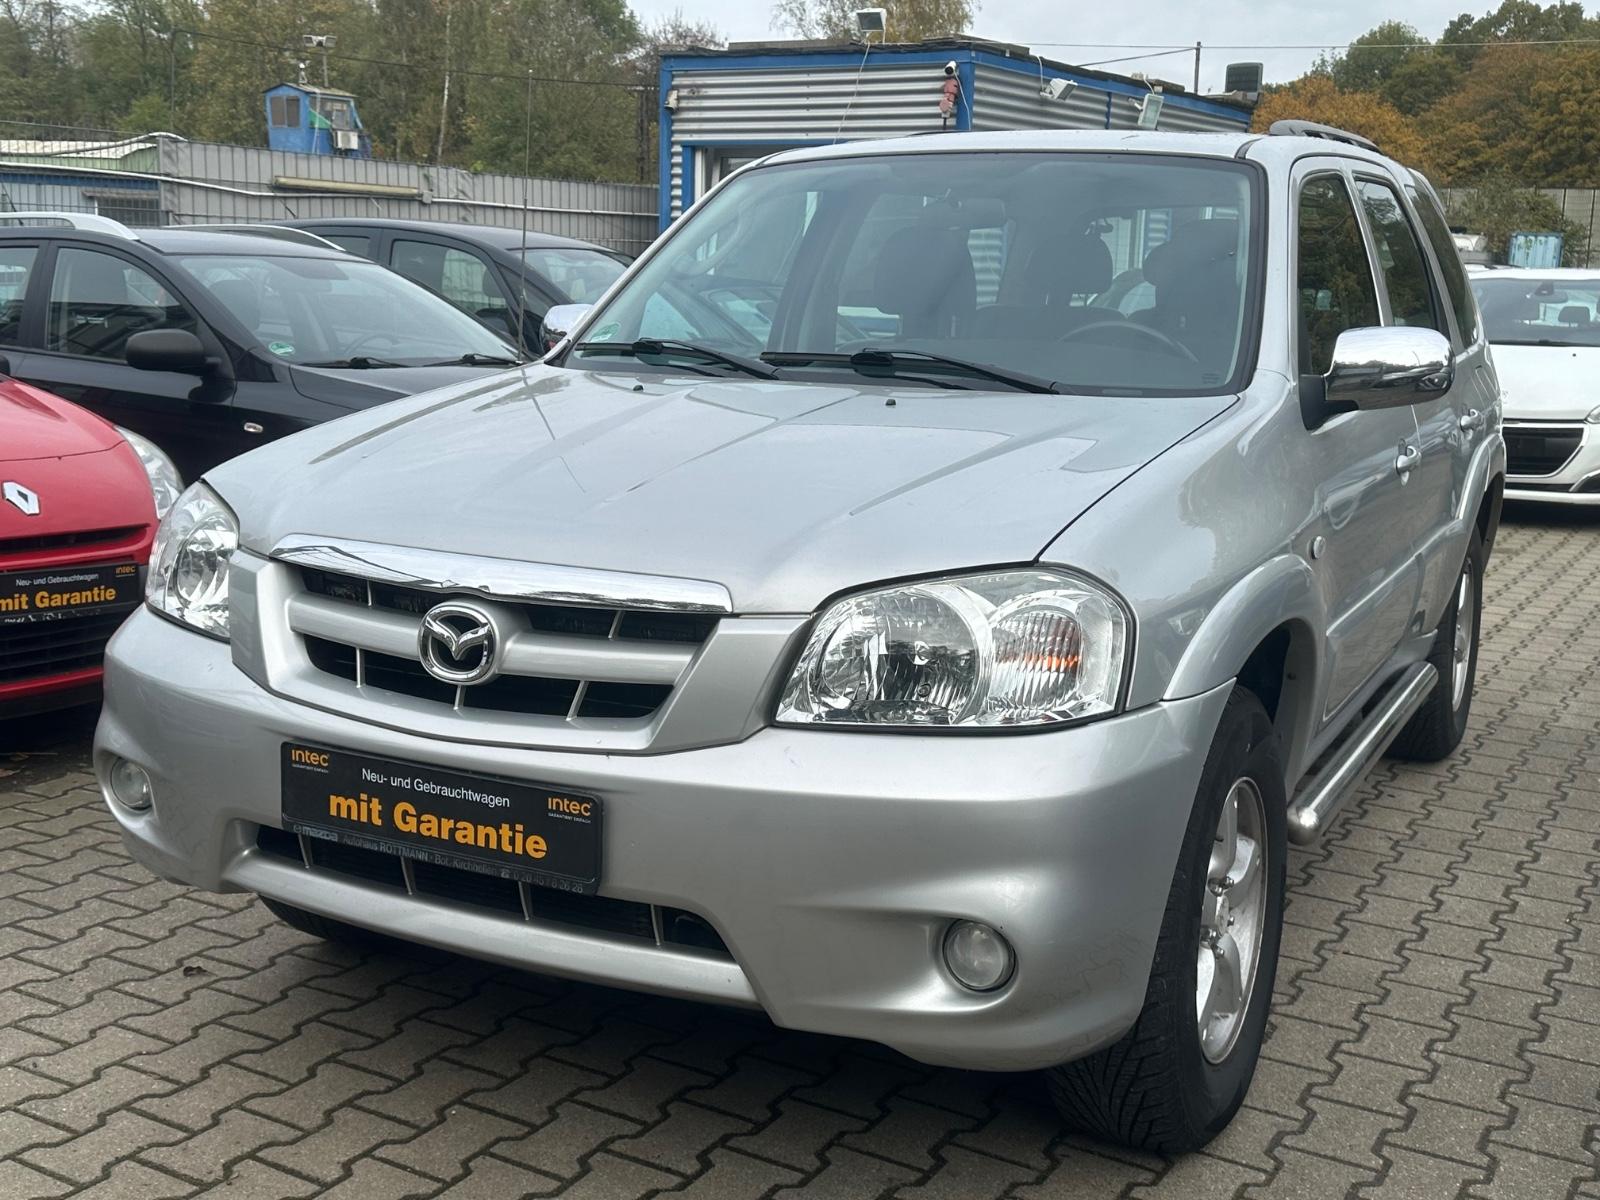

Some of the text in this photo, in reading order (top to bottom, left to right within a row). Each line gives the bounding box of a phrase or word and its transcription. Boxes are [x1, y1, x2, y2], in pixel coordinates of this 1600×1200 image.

[15, 573, 99, 587] Neu- und Gebrauchtwagen
[34, 585, 117, 609] Garantie
[291, 749, 329, 767] intec
[361, 768, 511, 808] Neu- und Gebrauchtwagen
[547, 797, 592, 817] intec
[329, 793, 548, 859] mit Garantie
[379, 842, 429, 862] ROTTMANN
